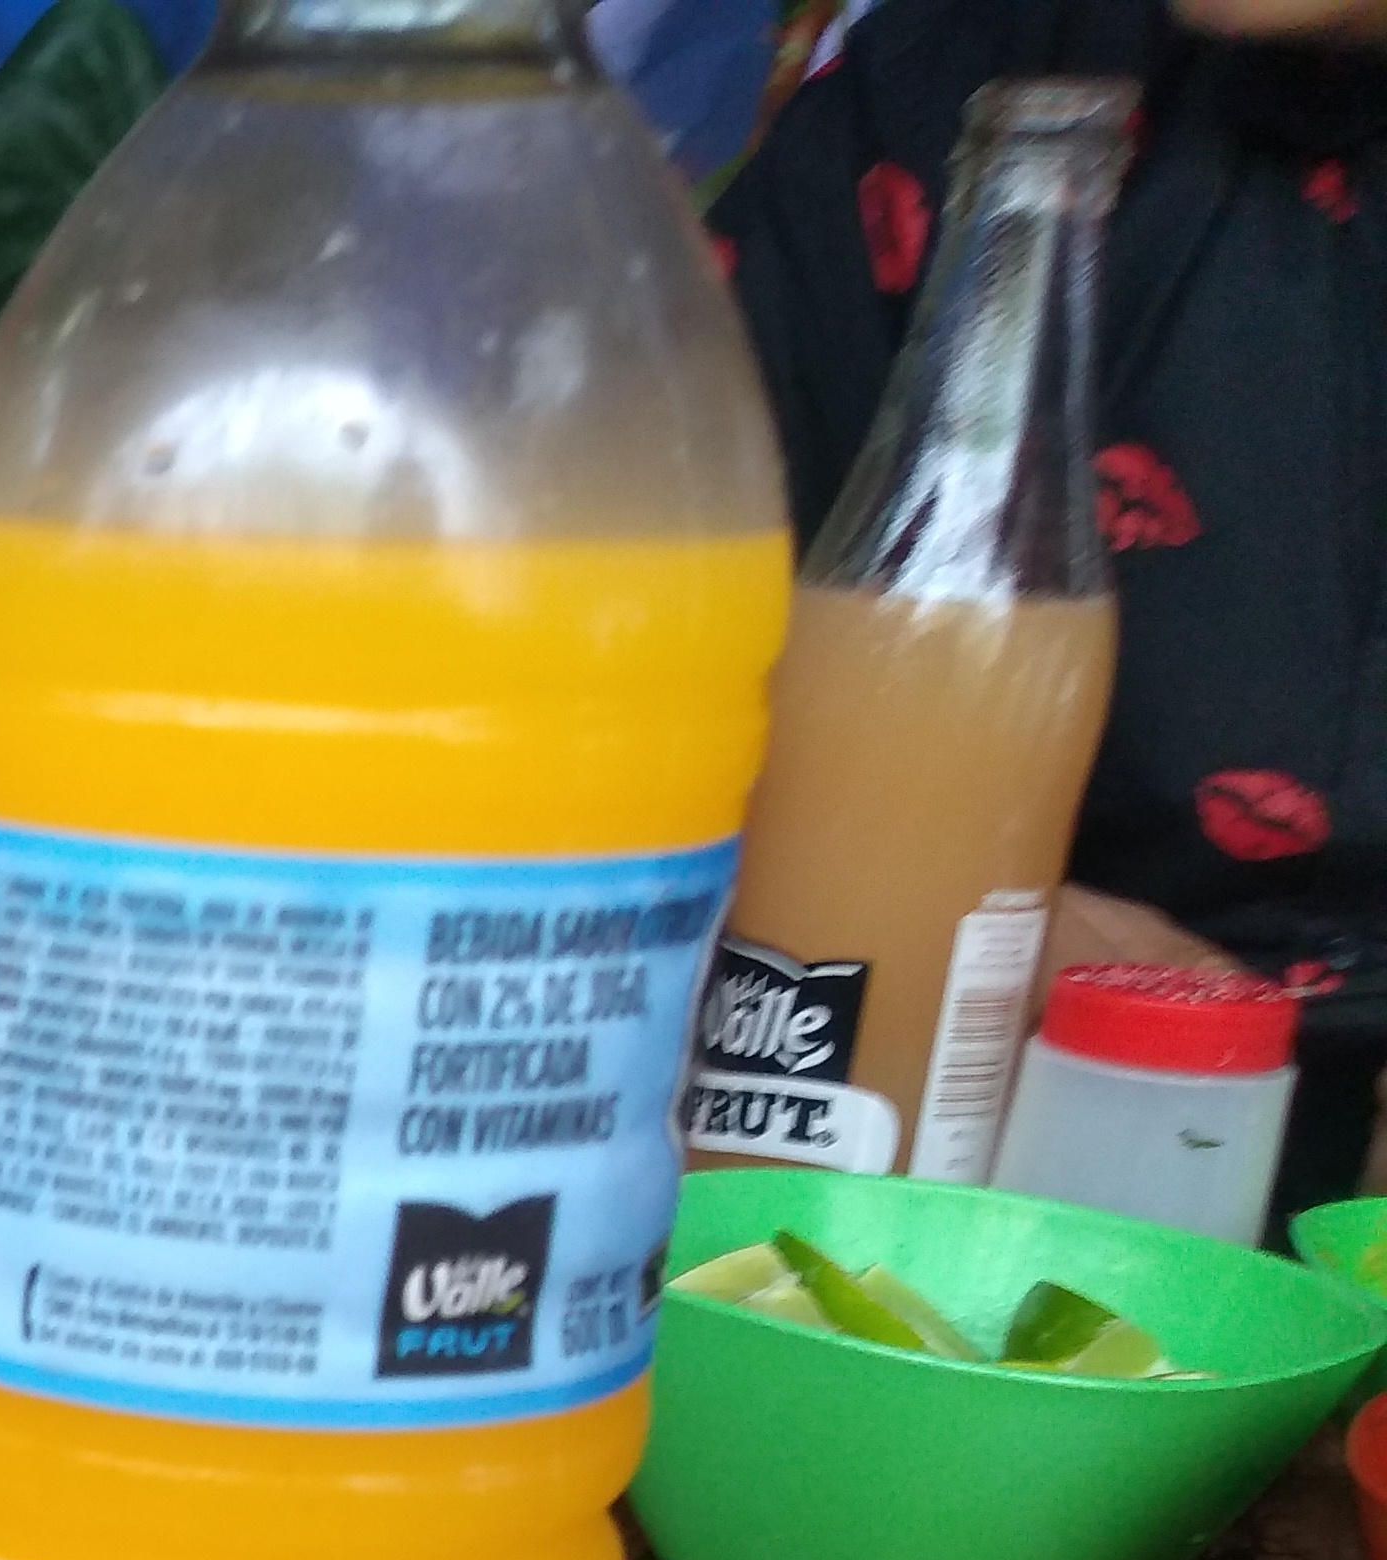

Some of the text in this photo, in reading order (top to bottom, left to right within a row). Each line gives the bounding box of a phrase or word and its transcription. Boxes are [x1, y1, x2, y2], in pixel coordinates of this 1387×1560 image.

[427, 910, 544, 964] BEBIDA
[418, 976, 483, 1031] CON
[407, 1035, 591, 1097] FORTIFICADA
[399, 1090, 622, 1156] CON VITAMINAS
[402, 1256, 529, 1323] Valle
[395, 1322, 517, 1360] FRUT
